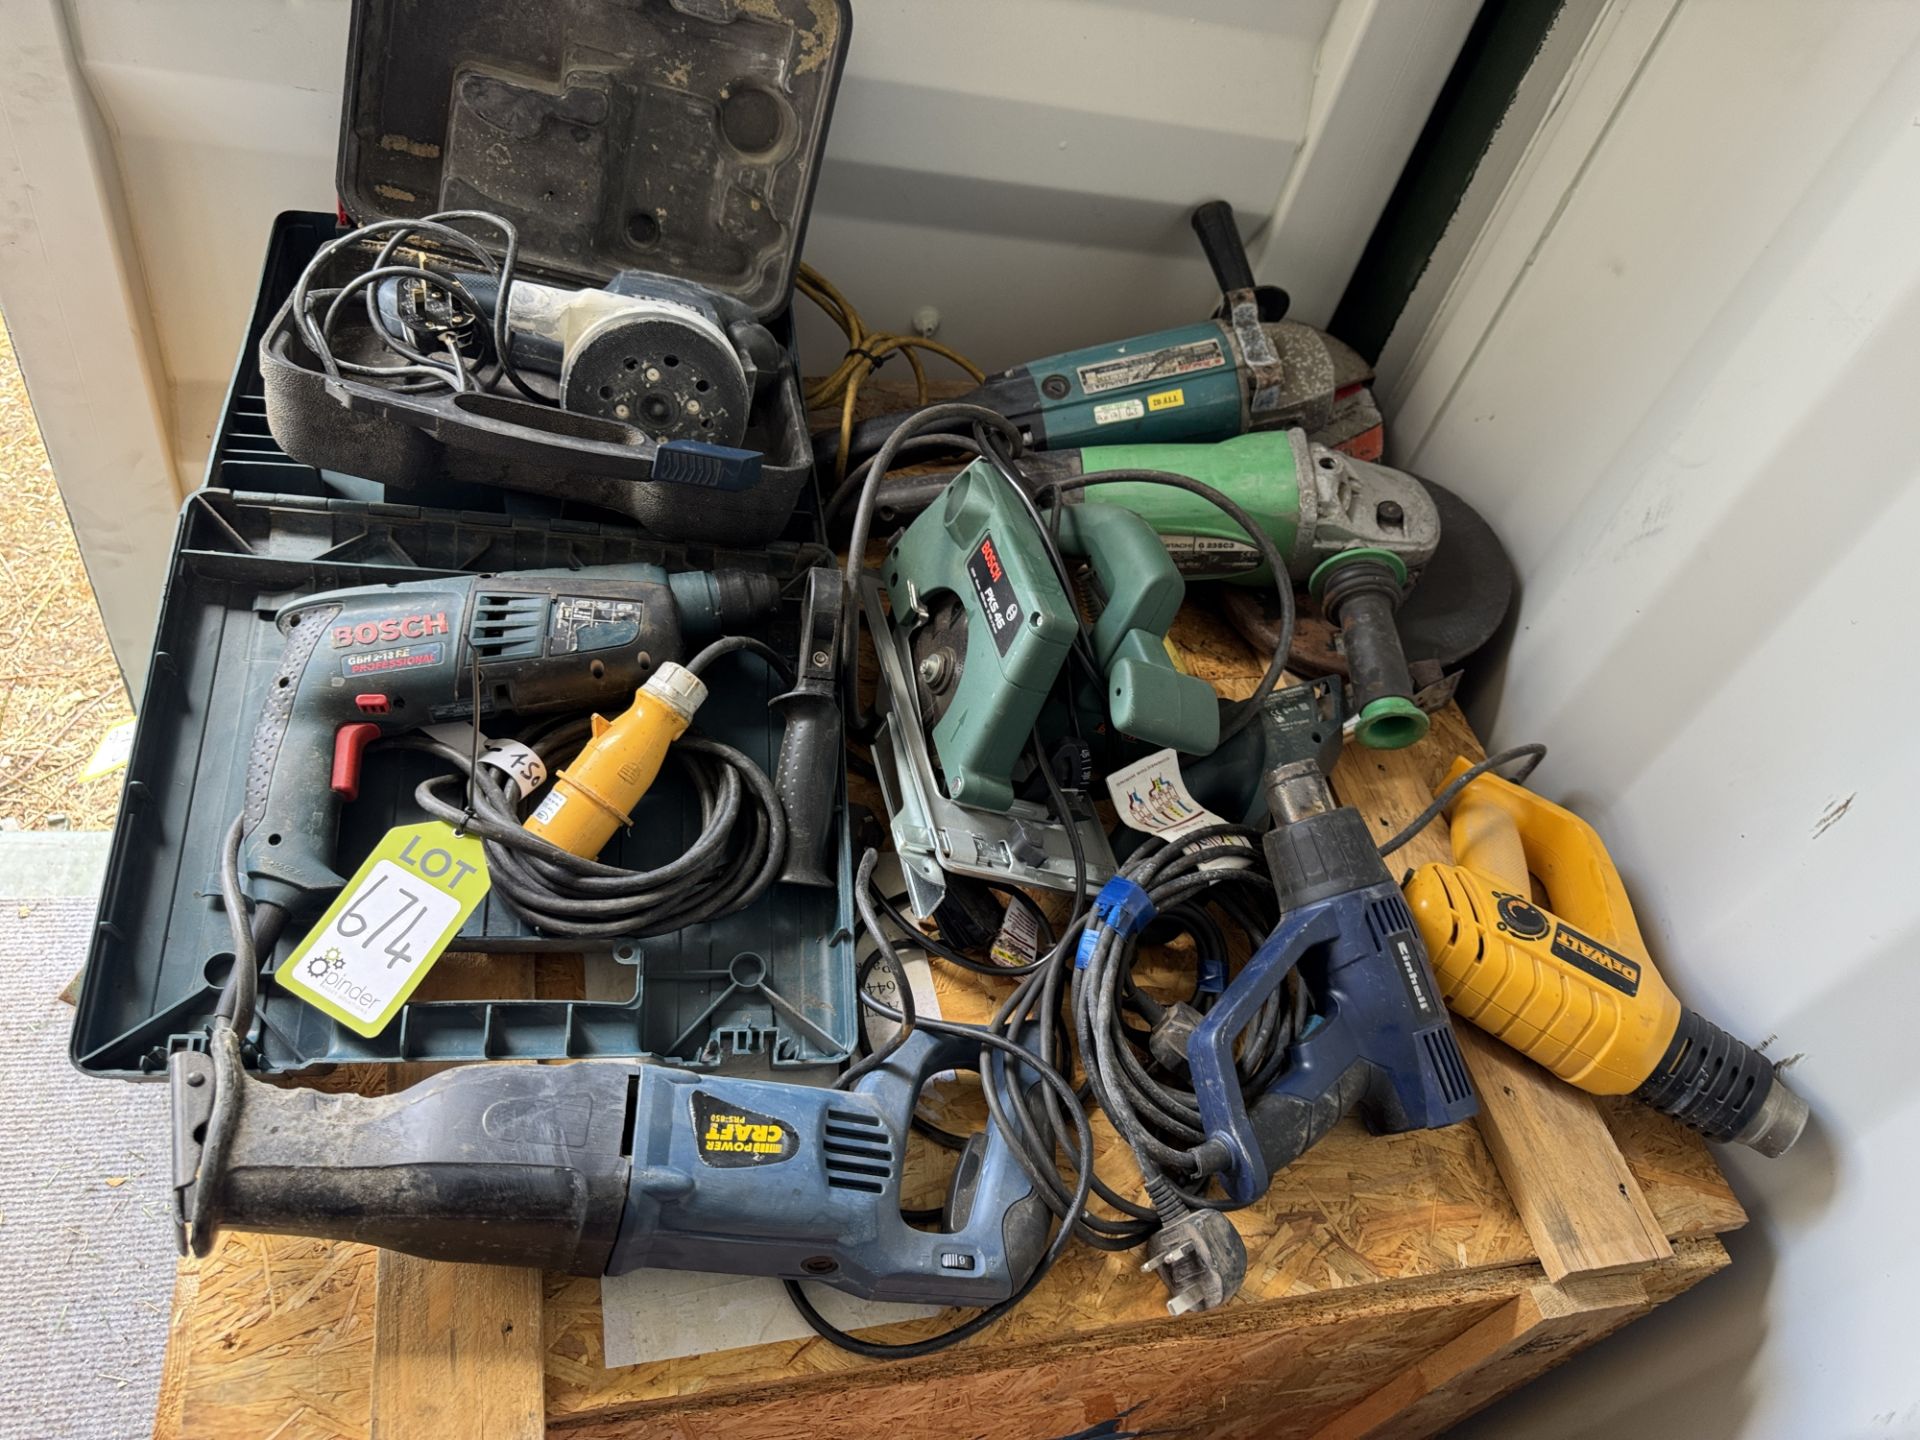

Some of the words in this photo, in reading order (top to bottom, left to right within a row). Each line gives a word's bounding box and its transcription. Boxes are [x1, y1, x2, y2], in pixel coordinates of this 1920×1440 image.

[981, 541, 1003, 582] BOSCH
[984, 586, 1000, 613] PKS
[993, 612, 1006, 630] 46
[332, 611, 448, 648] BOSCH
[348, 655, 371, 665] GBH
[351, 655, 434, 673] PROFESSIONAL
[399, 834, 476, 891] LOT
[336, 875, 428, 968] 674
[320, 971, 381, 1009] pinder
[867, 981, 895, 995] 644
[1397, 940, 1429, 1010] Einhell
[705, 1123, 783, 1141] CRAFT
[705, 1141, 752, 1152] POWER
